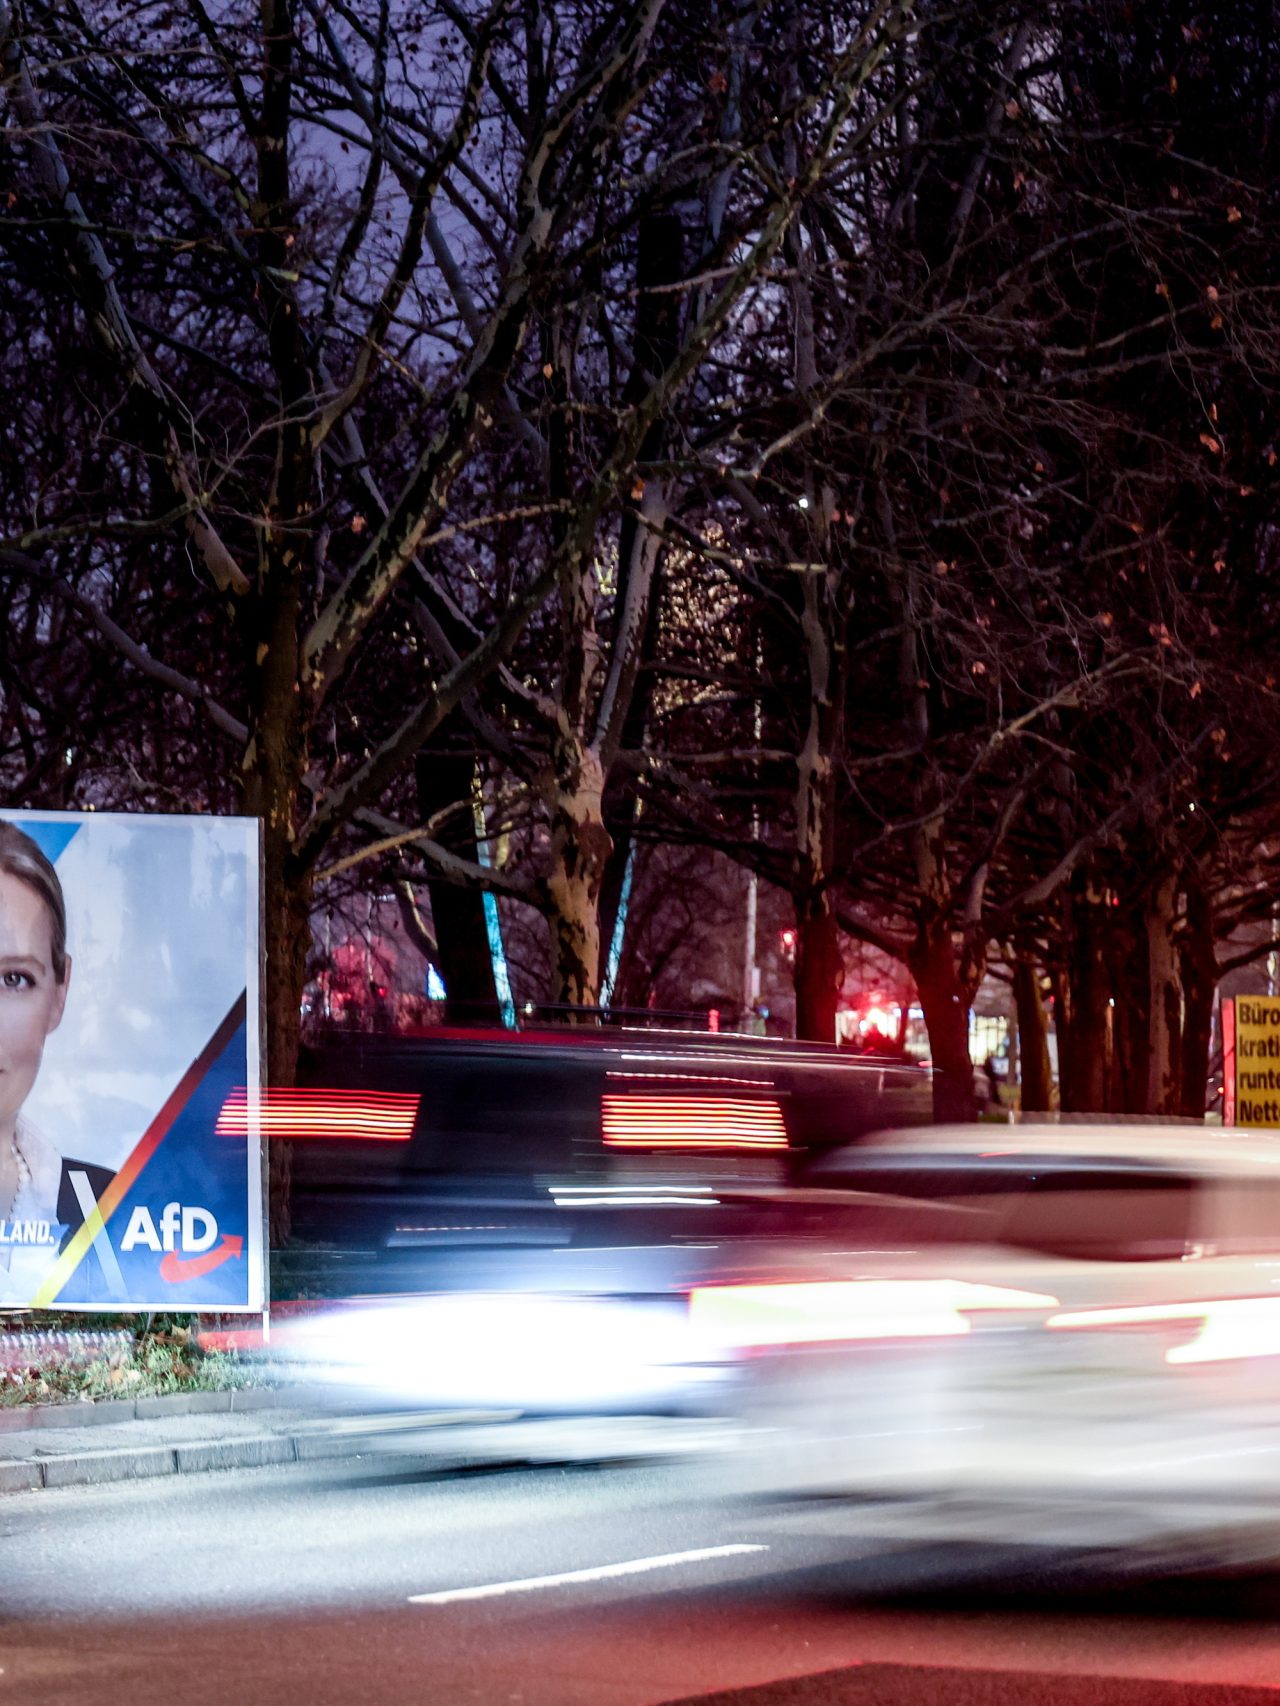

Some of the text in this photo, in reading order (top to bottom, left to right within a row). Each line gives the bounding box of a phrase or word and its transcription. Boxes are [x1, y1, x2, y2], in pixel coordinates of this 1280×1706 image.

[1239, 1002, 1280, 1026] Büro
[1240, 1100, 1280, 1122] Nett
[120, 1202, 218, 1252] AfD
